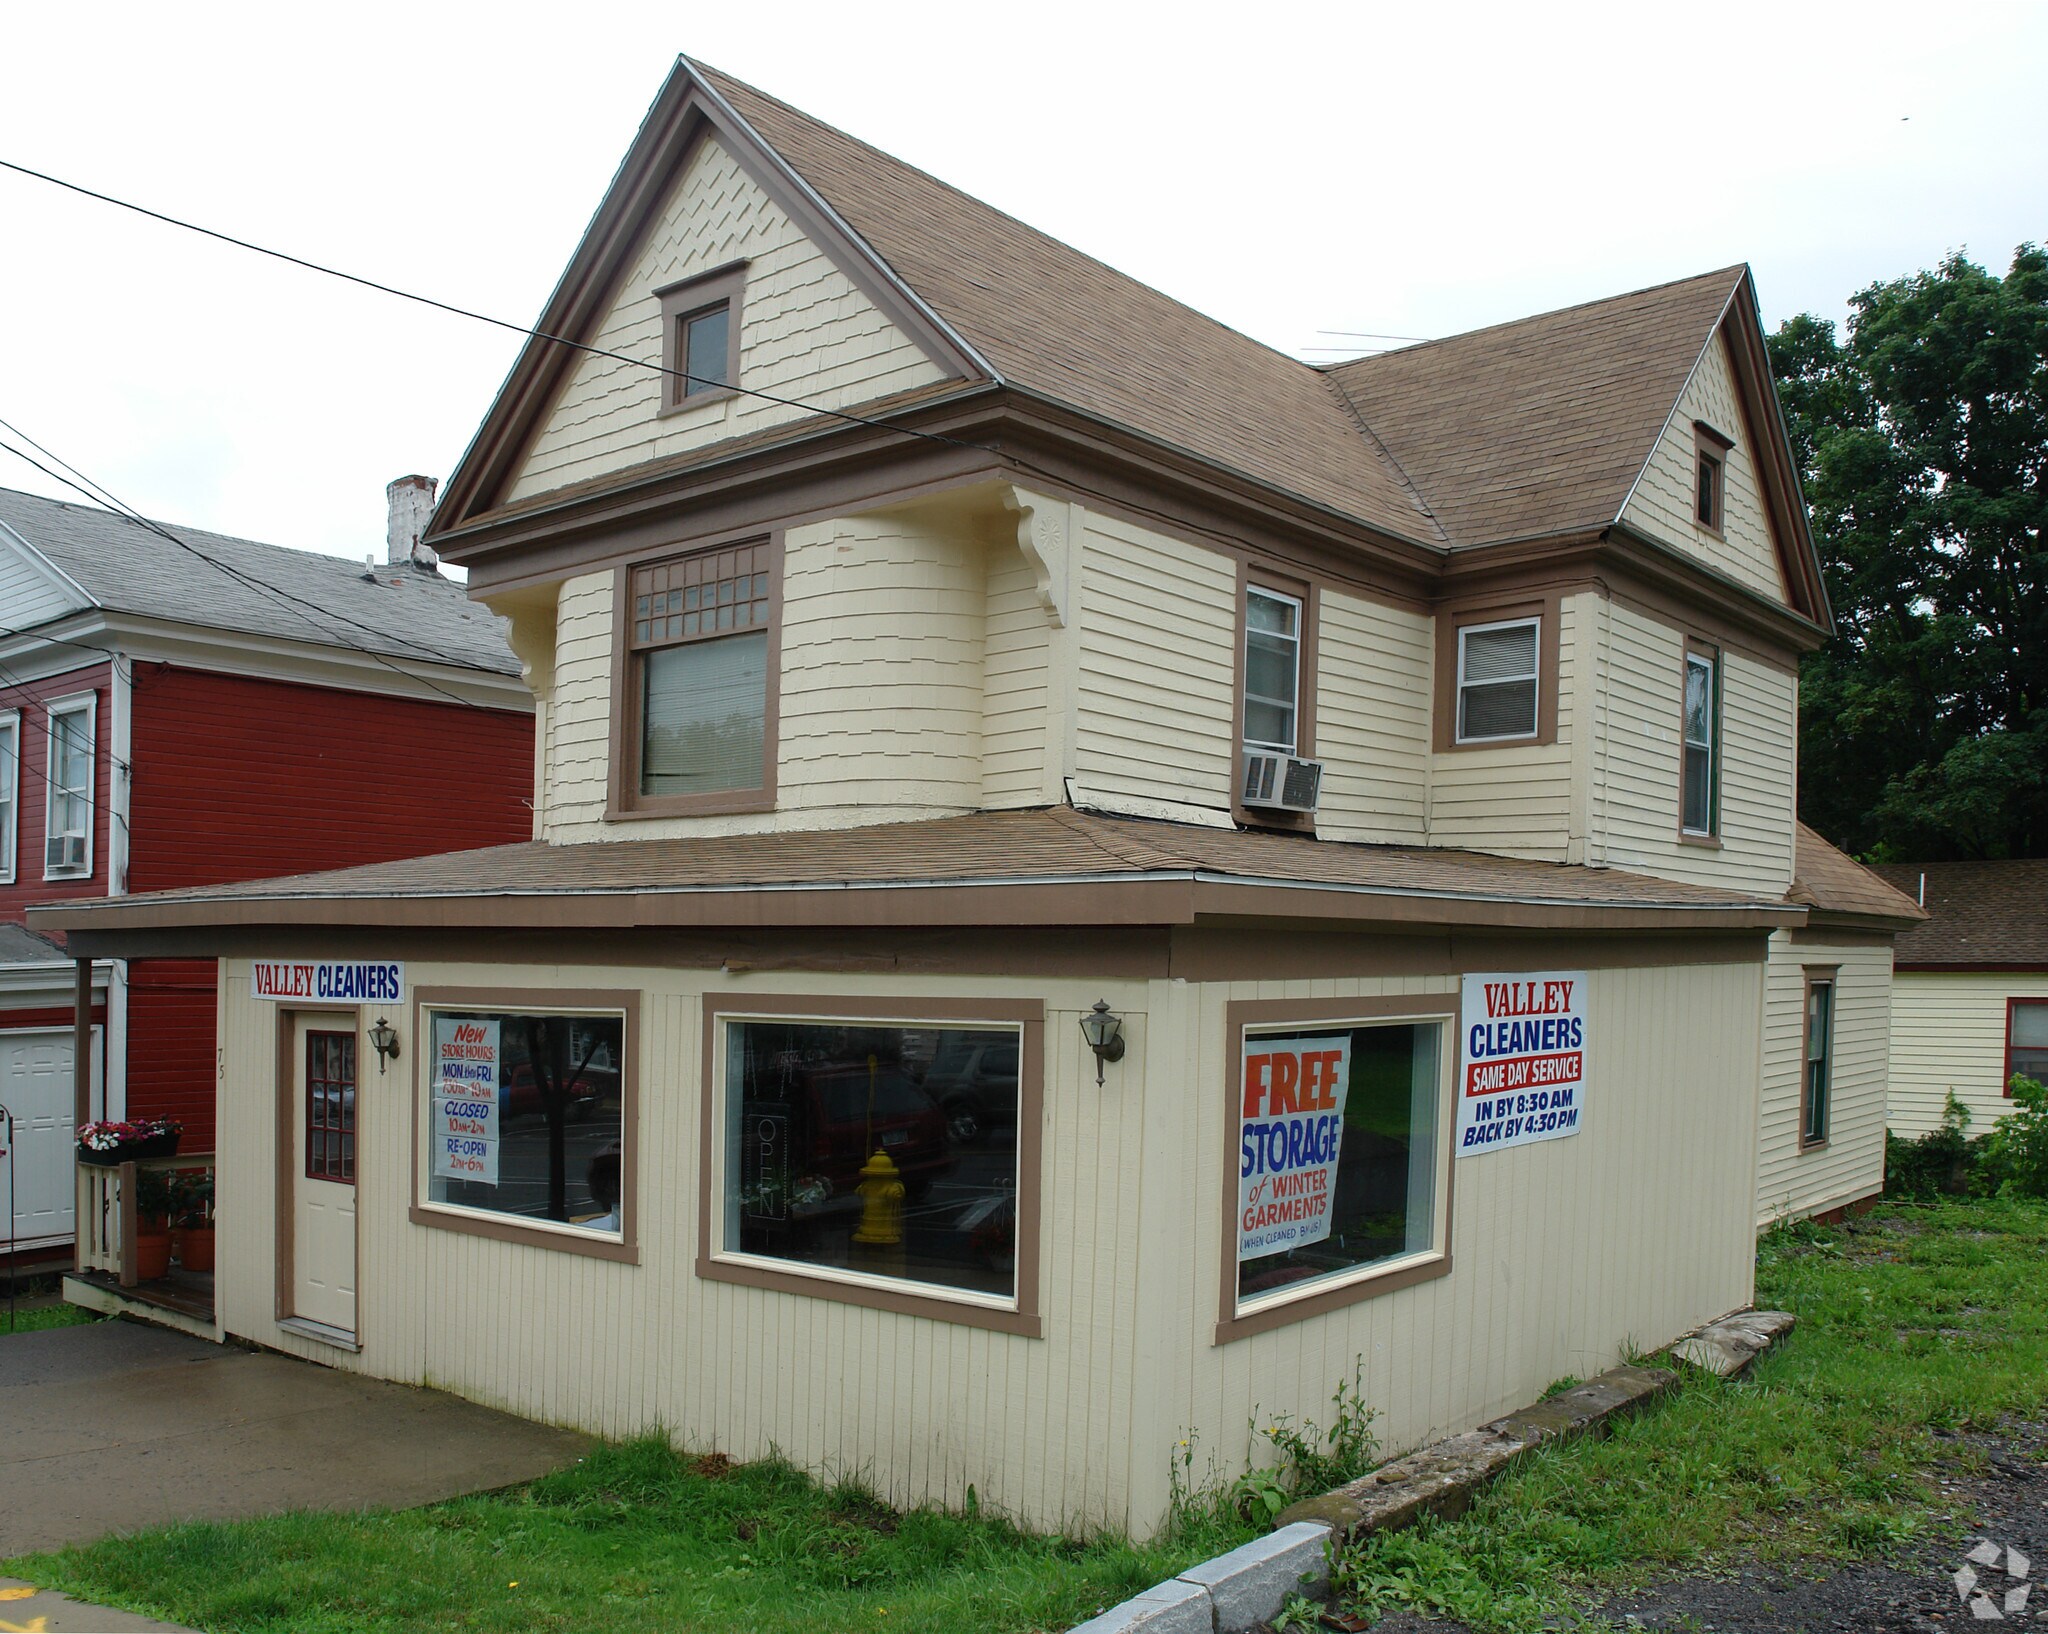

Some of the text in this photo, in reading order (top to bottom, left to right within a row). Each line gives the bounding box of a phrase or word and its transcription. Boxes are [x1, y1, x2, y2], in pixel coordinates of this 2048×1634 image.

[255, 964, 399, 999] VALLEY CLEANERS
[1484, 981, 1574, 1018] VALLEY
[453, 1023, 487, 1043] New
[1470, 1017, 1582, 1058] CLEANERS
[441, 1044, 496, 1060] STORE HOURS:
[1243, 1050, 1342, 1118] FREE
[1473, 1056, 1579, 1092] SAME DAY SERVICE
[445, 1101, 488, 1119] CLOSED
[1475, 1088, 1573, 1122] IN BY 8:30 AM
[1463, 1108, 1578, 1147] BACK BY 4:30 PM
[447, 1138, 487, 1157] RE-OPEN
[1241, 1115, 1339, 1178] STORAGE
[758, 1118, 776, 1216] OPEN
[1249, 1168, 1328, 1207] of WINTER
[1243, 1192, 1328, 1232] GARMENTS
[1265, 1228, 1296, 1245] CLEANED
